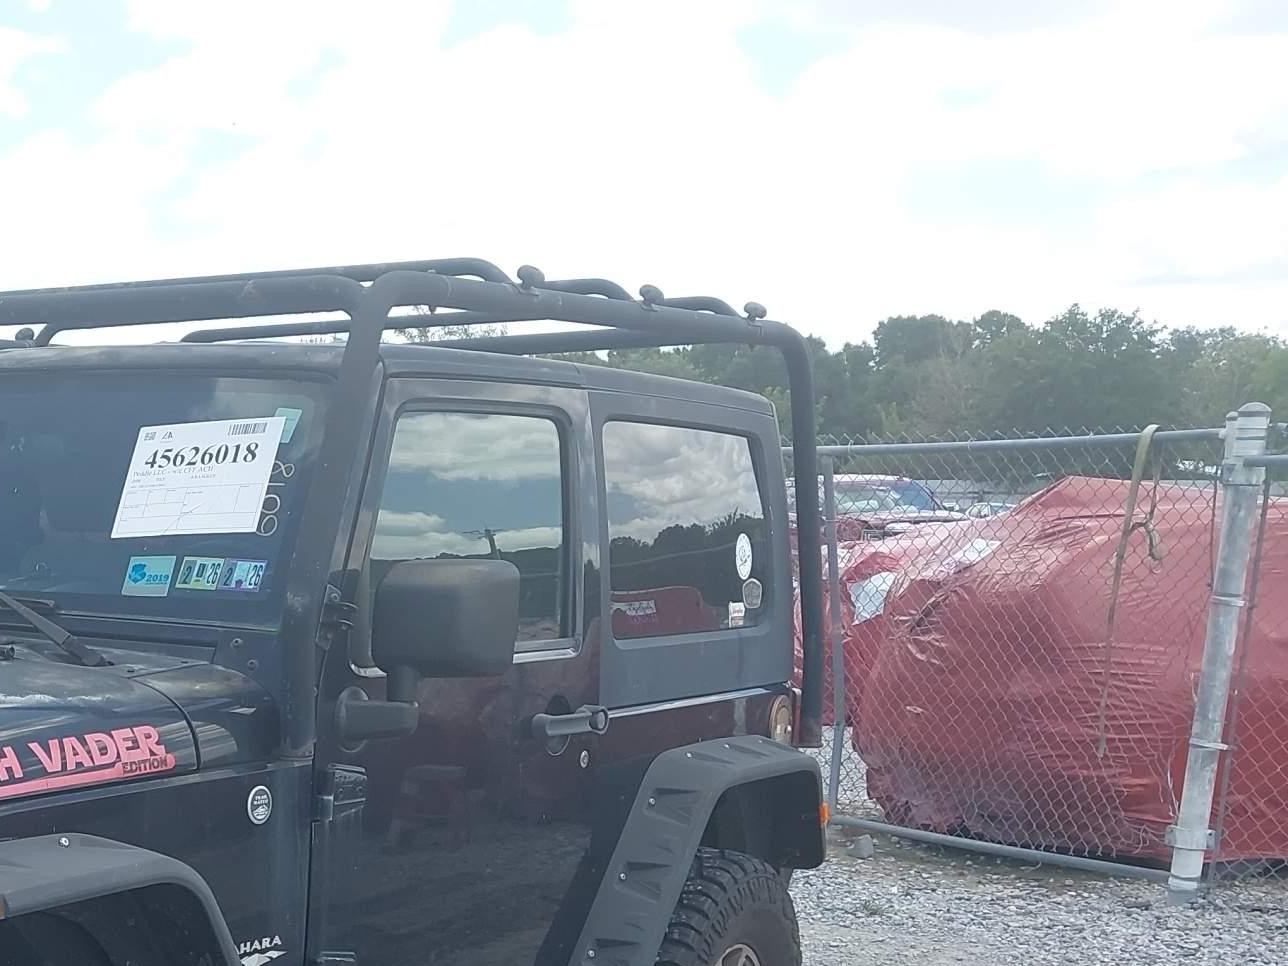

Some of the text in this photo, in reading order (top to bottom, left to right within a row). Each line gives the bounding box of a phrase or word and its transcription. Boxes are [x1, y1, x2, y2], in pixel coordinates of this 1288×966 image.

[144, 442, 259, 469] 45626018
[146, 574, 169, 583] 2019
[206, 563, 222, 585] 26
[248, 565, 264, 587] 26
[27, 725, 167, 773] VADER
[121, 754, 169, 775] EDITION
